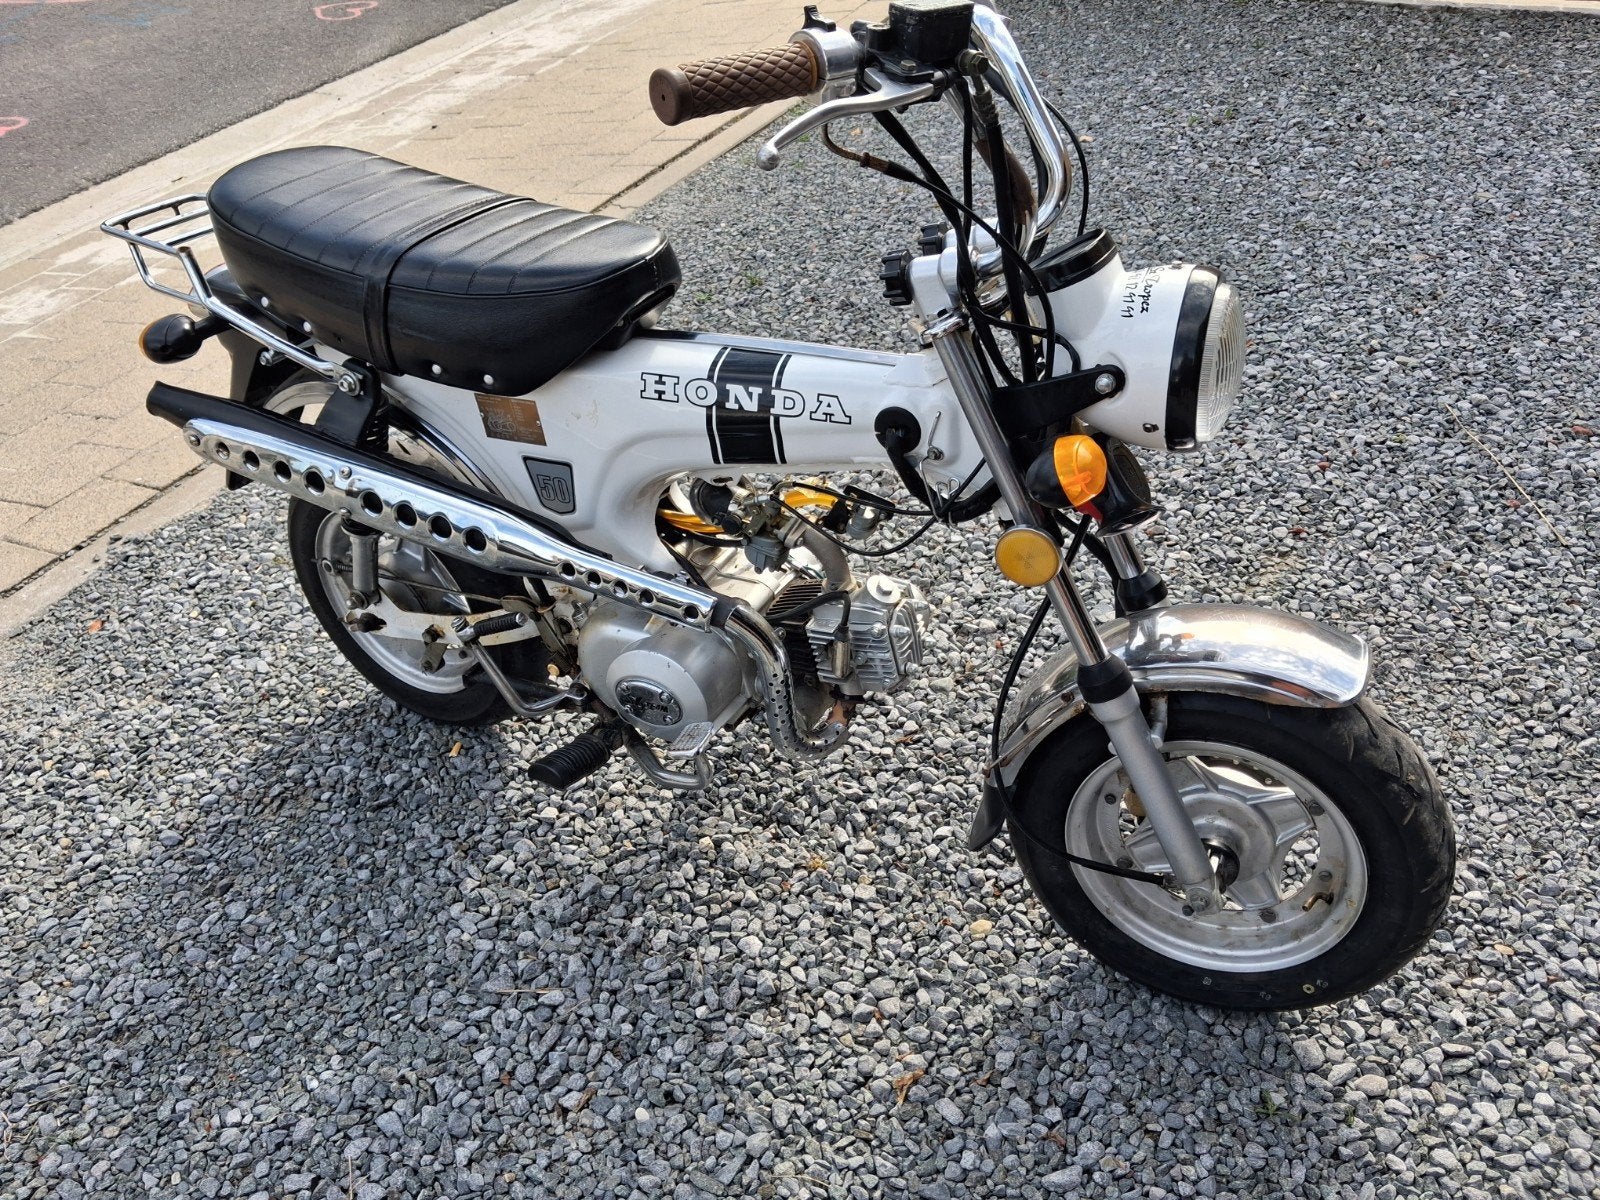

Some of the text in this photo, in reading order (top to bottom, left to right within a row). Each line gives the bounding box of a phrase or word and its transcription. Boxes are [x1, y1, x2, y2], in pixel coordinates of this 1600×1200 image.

[1138, 275, 1160, 314] Tropez
[640, 371, 852, 425] HONDA
[536, 473, 571, 504] 50
